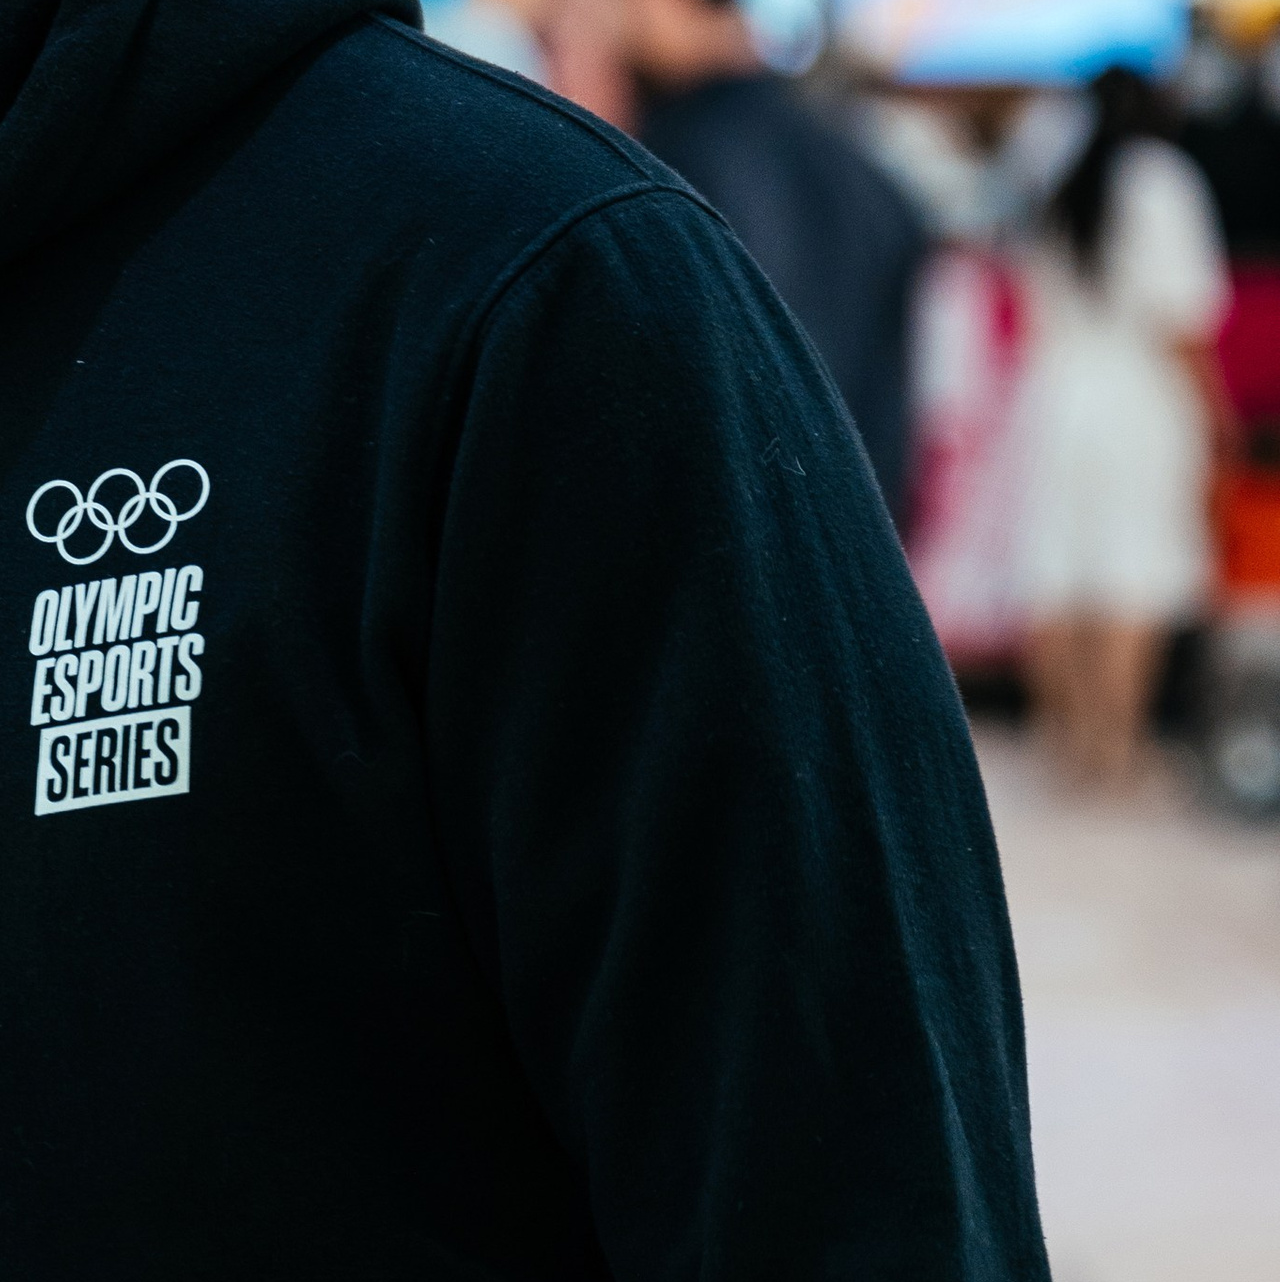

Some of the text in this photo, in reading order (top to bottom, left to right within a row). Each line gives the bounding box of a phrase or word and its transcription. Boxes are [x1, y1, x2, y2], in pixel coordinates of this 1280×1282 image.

[29, 565, 203, 655] OLYMPIC
[30, 633, 204, 725] ESPORTS
[47, 718, 179, 802] SERIES
